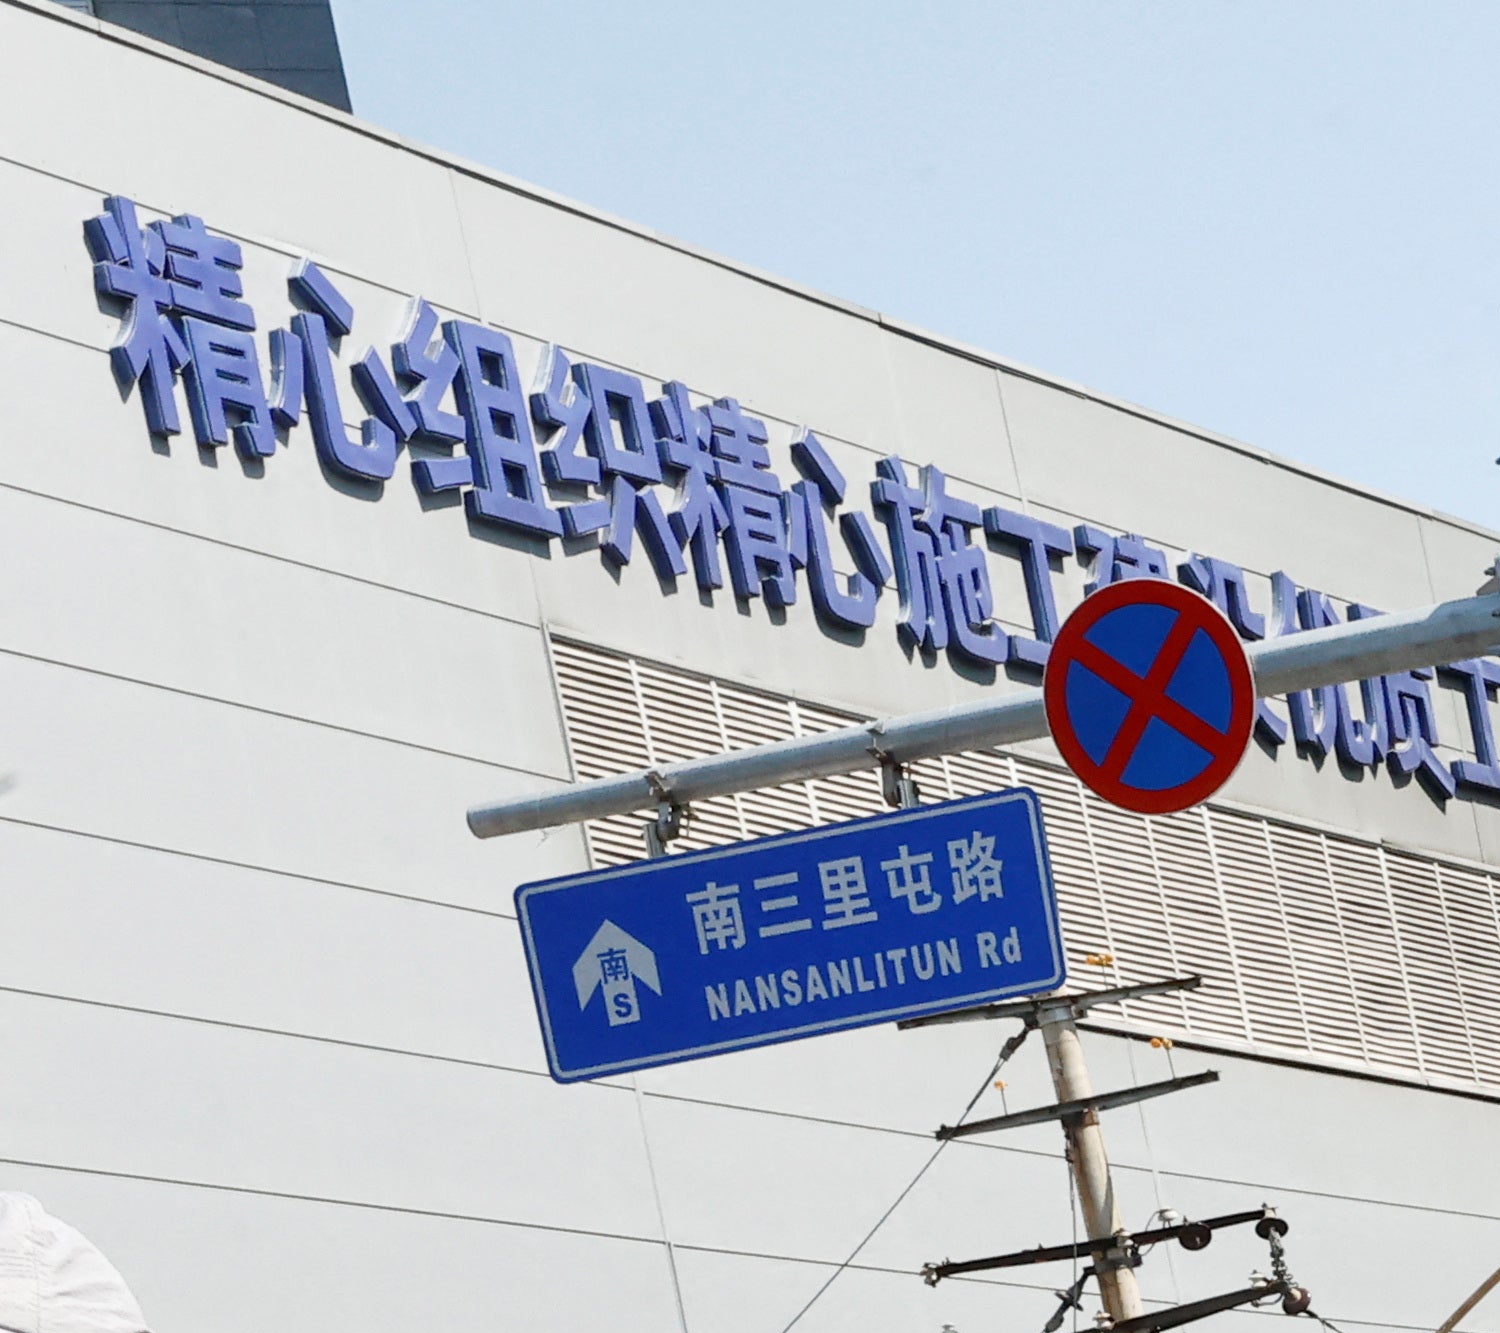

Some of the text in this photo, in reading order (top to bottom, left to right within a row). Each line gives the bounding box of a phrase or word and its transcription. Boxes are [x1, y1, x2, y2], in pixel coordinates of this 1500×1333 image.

[685, 830, 1005, 955] 南三里屯路
[596, 947, 630, 983] 南
[705, 926, 1023, 1021] NANSANLITUN Rd
[612, 992, 635, 1019] S
